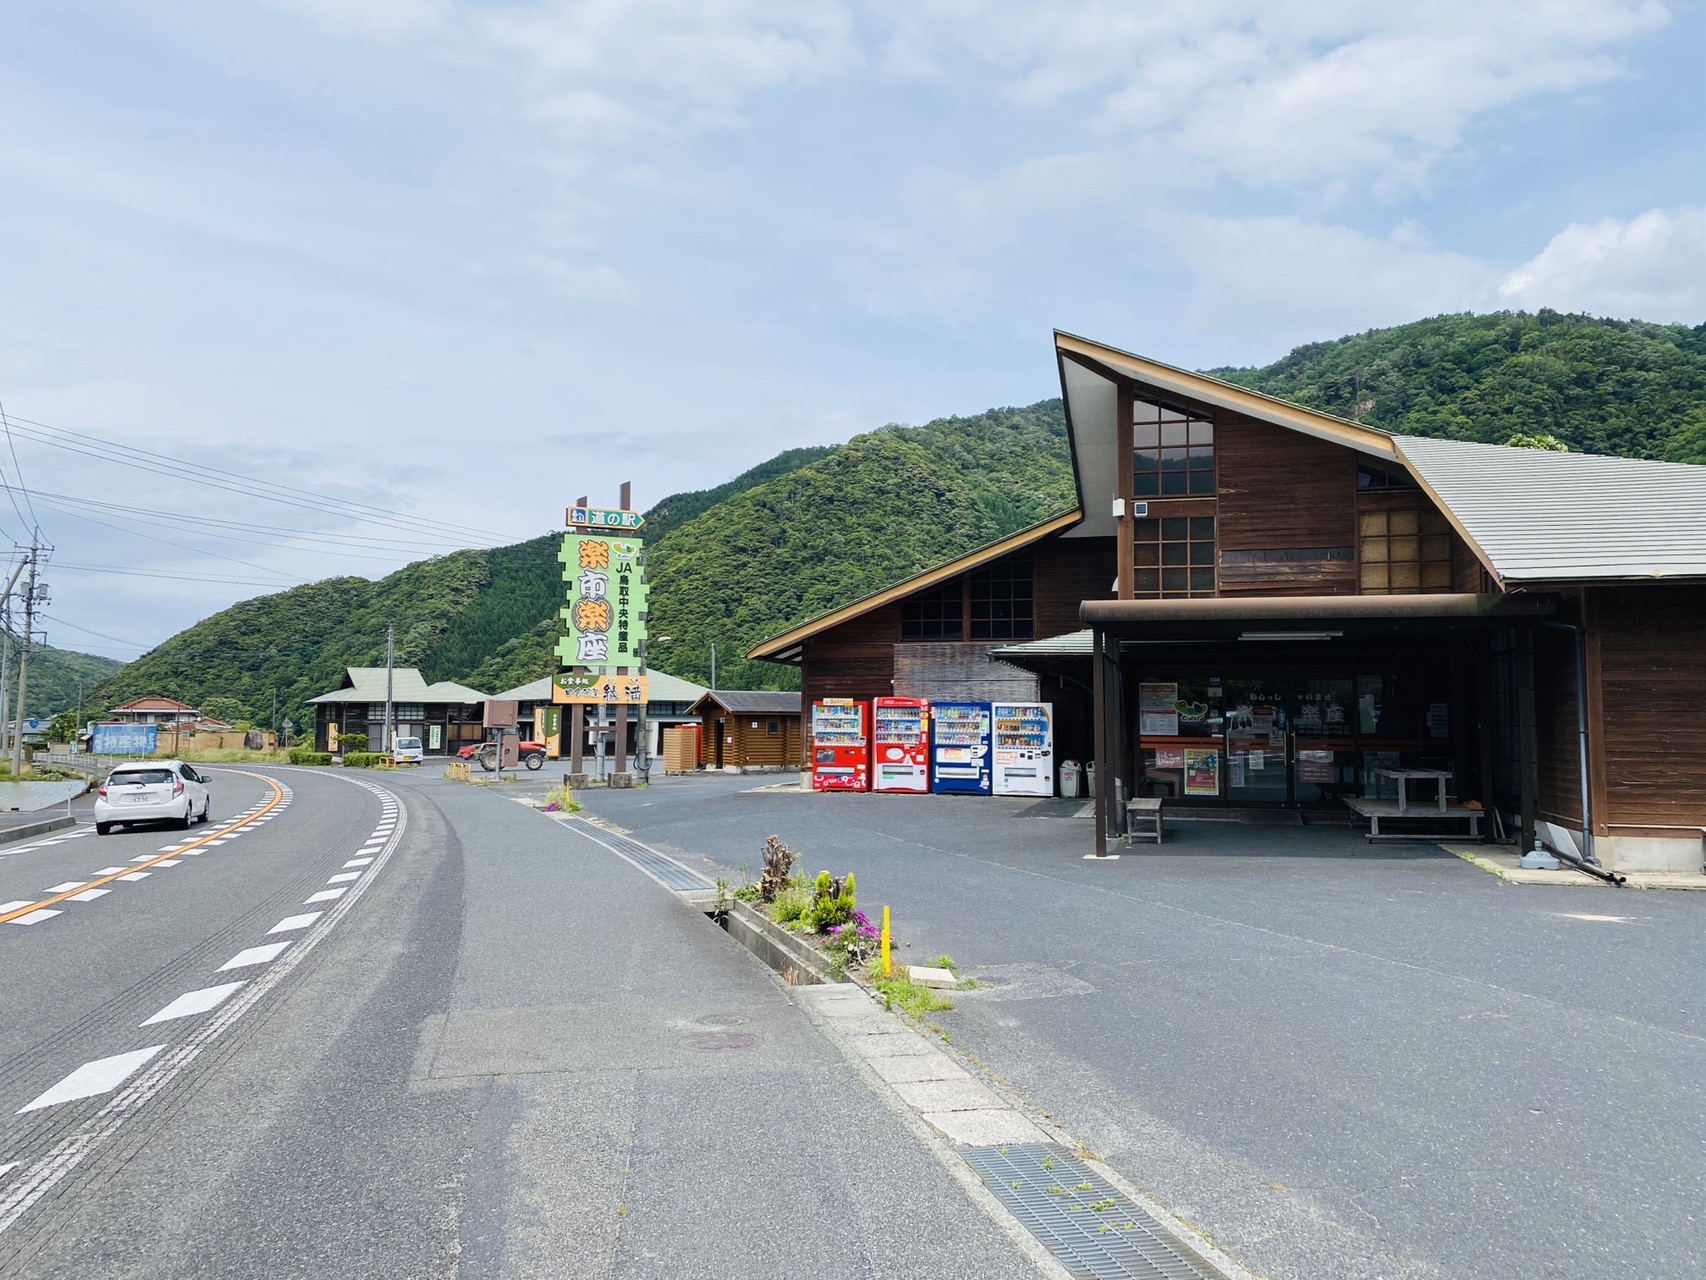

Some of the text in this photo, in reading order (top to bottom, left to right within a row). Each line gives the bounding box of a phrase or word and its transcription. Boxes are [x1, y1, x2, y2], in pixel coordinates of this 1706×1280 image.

[590, 510, 637, 527] 道の駅
[577, 540, 610, 661] 楽市楽座
[560, 677, 589, 685] お食事処
